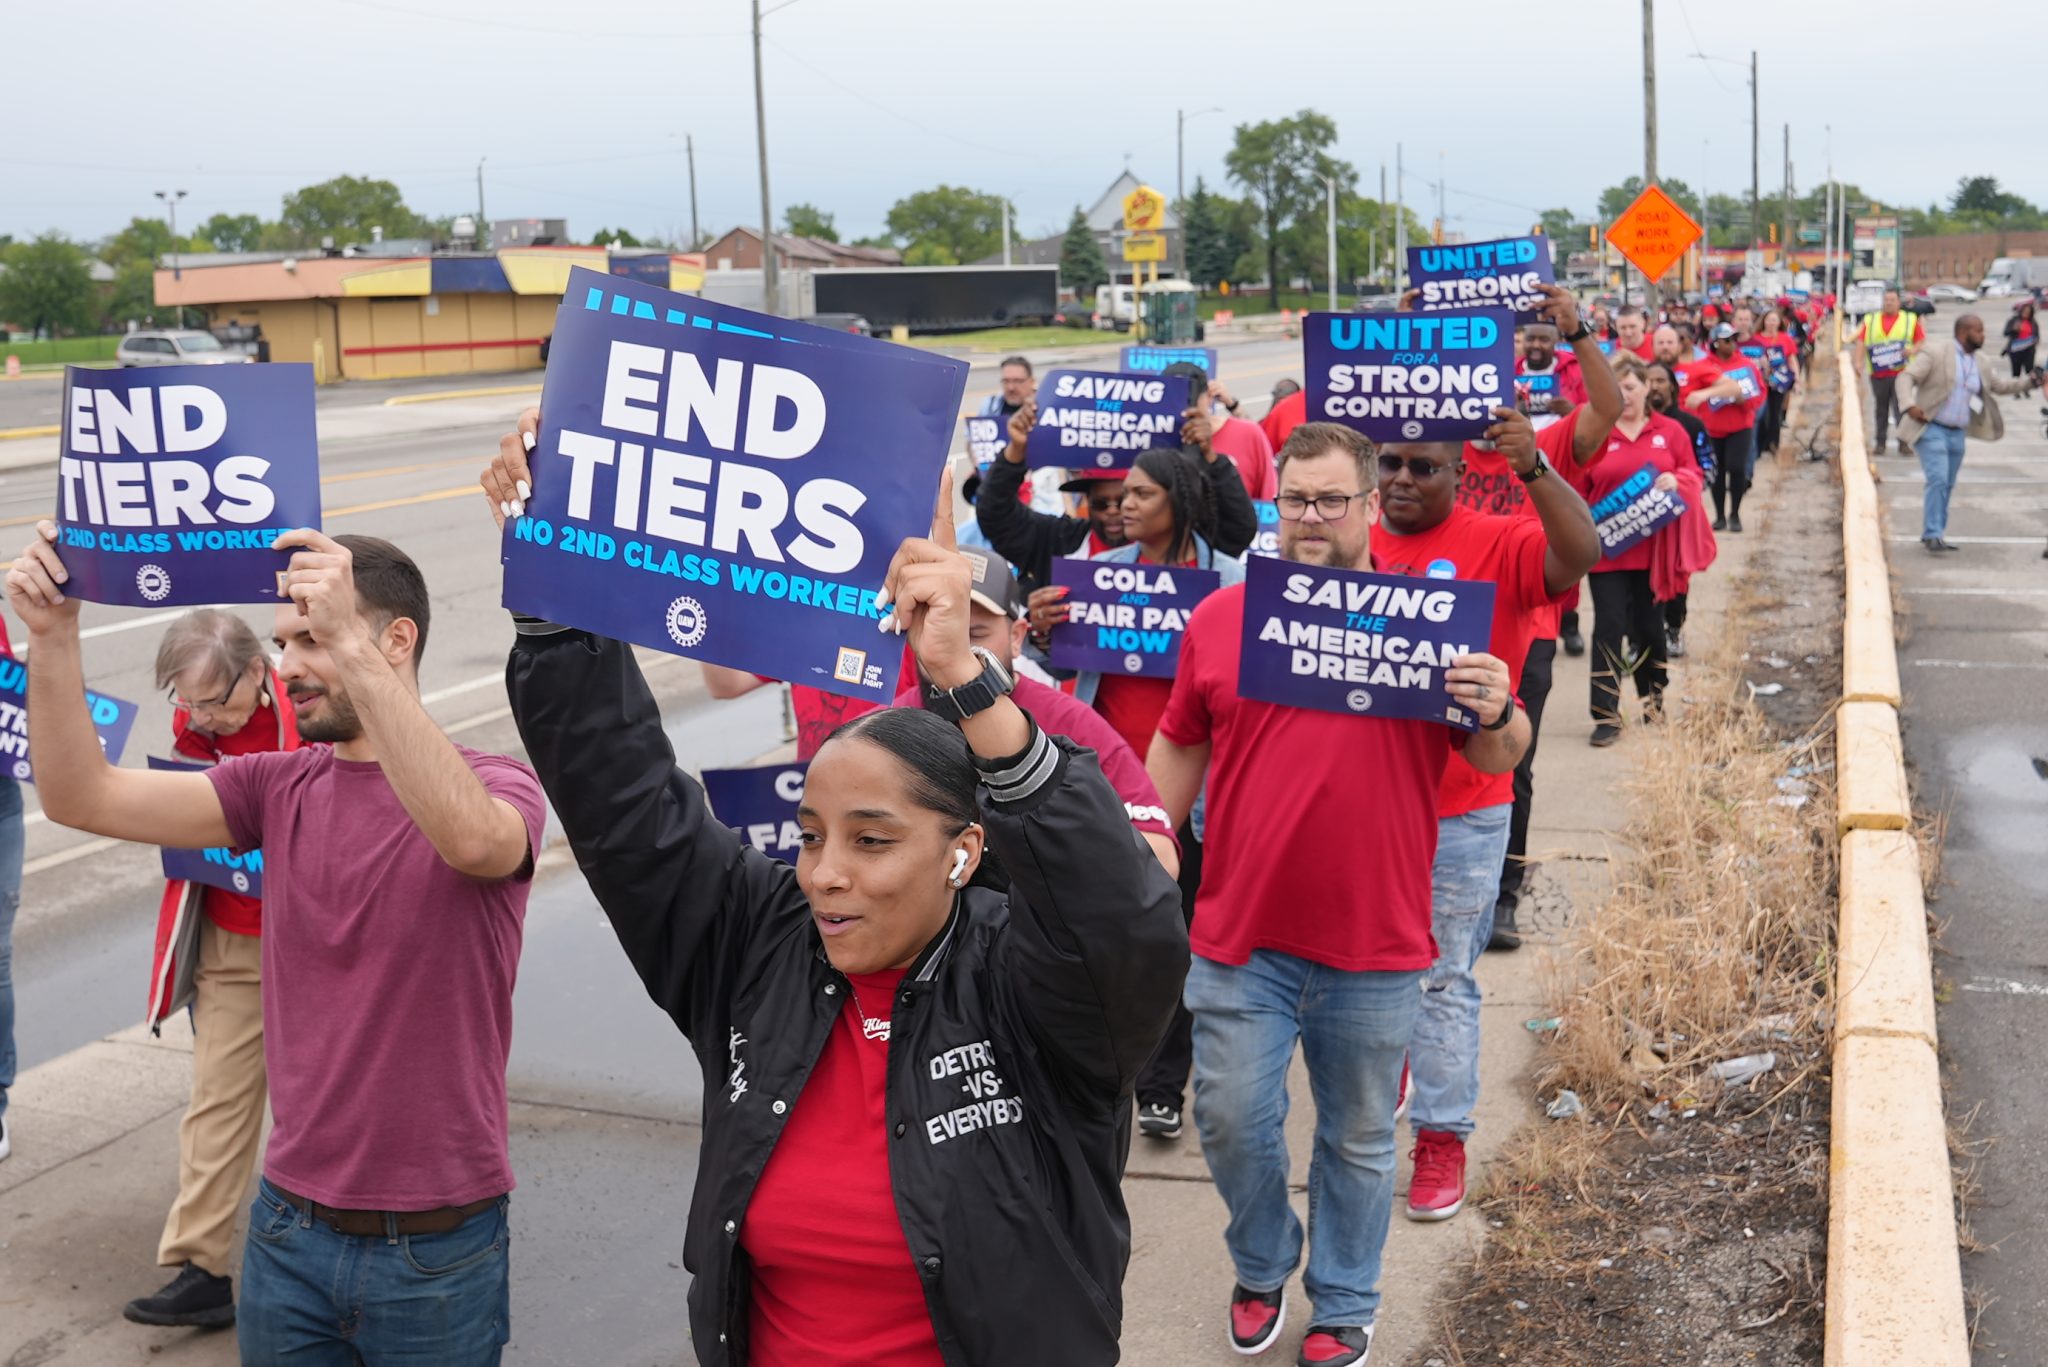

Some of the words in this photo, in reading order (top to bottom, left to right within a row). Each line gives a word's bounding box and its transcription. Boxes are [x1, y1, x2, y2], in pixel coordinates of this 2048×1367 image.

[1636, 212, 1669, 222] ROAD
[1420, 239, 1537, 272] UNITED
[1633, 243, 1675, 255] AHEAD
[1422, 271, 1541, 302] STRONG
[1329, 316, 1498, 350] UNITED
[1392, 353, 1425, 365] FOR
[1427, 353, 1440, 364] A
[1054, 375, 1165, 403] SAVING
[1327, 364, 1499, 394] STRONG
[601, 340, 827, 460] END
[1095, 400, 1123, 412] THE
[1324, 396, 1502, 421] CONTRACT
[71, 384, 227, 454] END
[970, 419, 998, 441] END
[1039, 407, 1175, 433] AMERICAN
[1060, 428, 1150, 450] DREAM
[60, 455, 275, 527] TIERS
[558, 429, 867, 574] TIERS
[1596, 488, 1665, 538] STRONG
[1604, 494, 1674, 547] CONTRACT
[66, 528, 96, 549] 2ND
[99, 531, 172, 553] CLASS
[515, 516, 553, 546] NO
[559, 525, 616, 560] 2ND
[624, 541, 721, 586] CLASS
[1094, 567, 1177, 594] COLA
[1119, 593, 1150, 606] AND
[1282, 573, 1456, 622] SAVING
[1069, 601, 1136, 629] FAIR
[1346, 612, 1388, 632] THE
[1098, 627, 1171, 654] NOW
[1259, 616, 1470, 668] AMERICAN
[865, 671, 878, 681] THE
[866, 665, 882, 675] JOIN
[1291, 649, 1431, 690] DREAM
[863, 678, 883, 689] FIGHT
